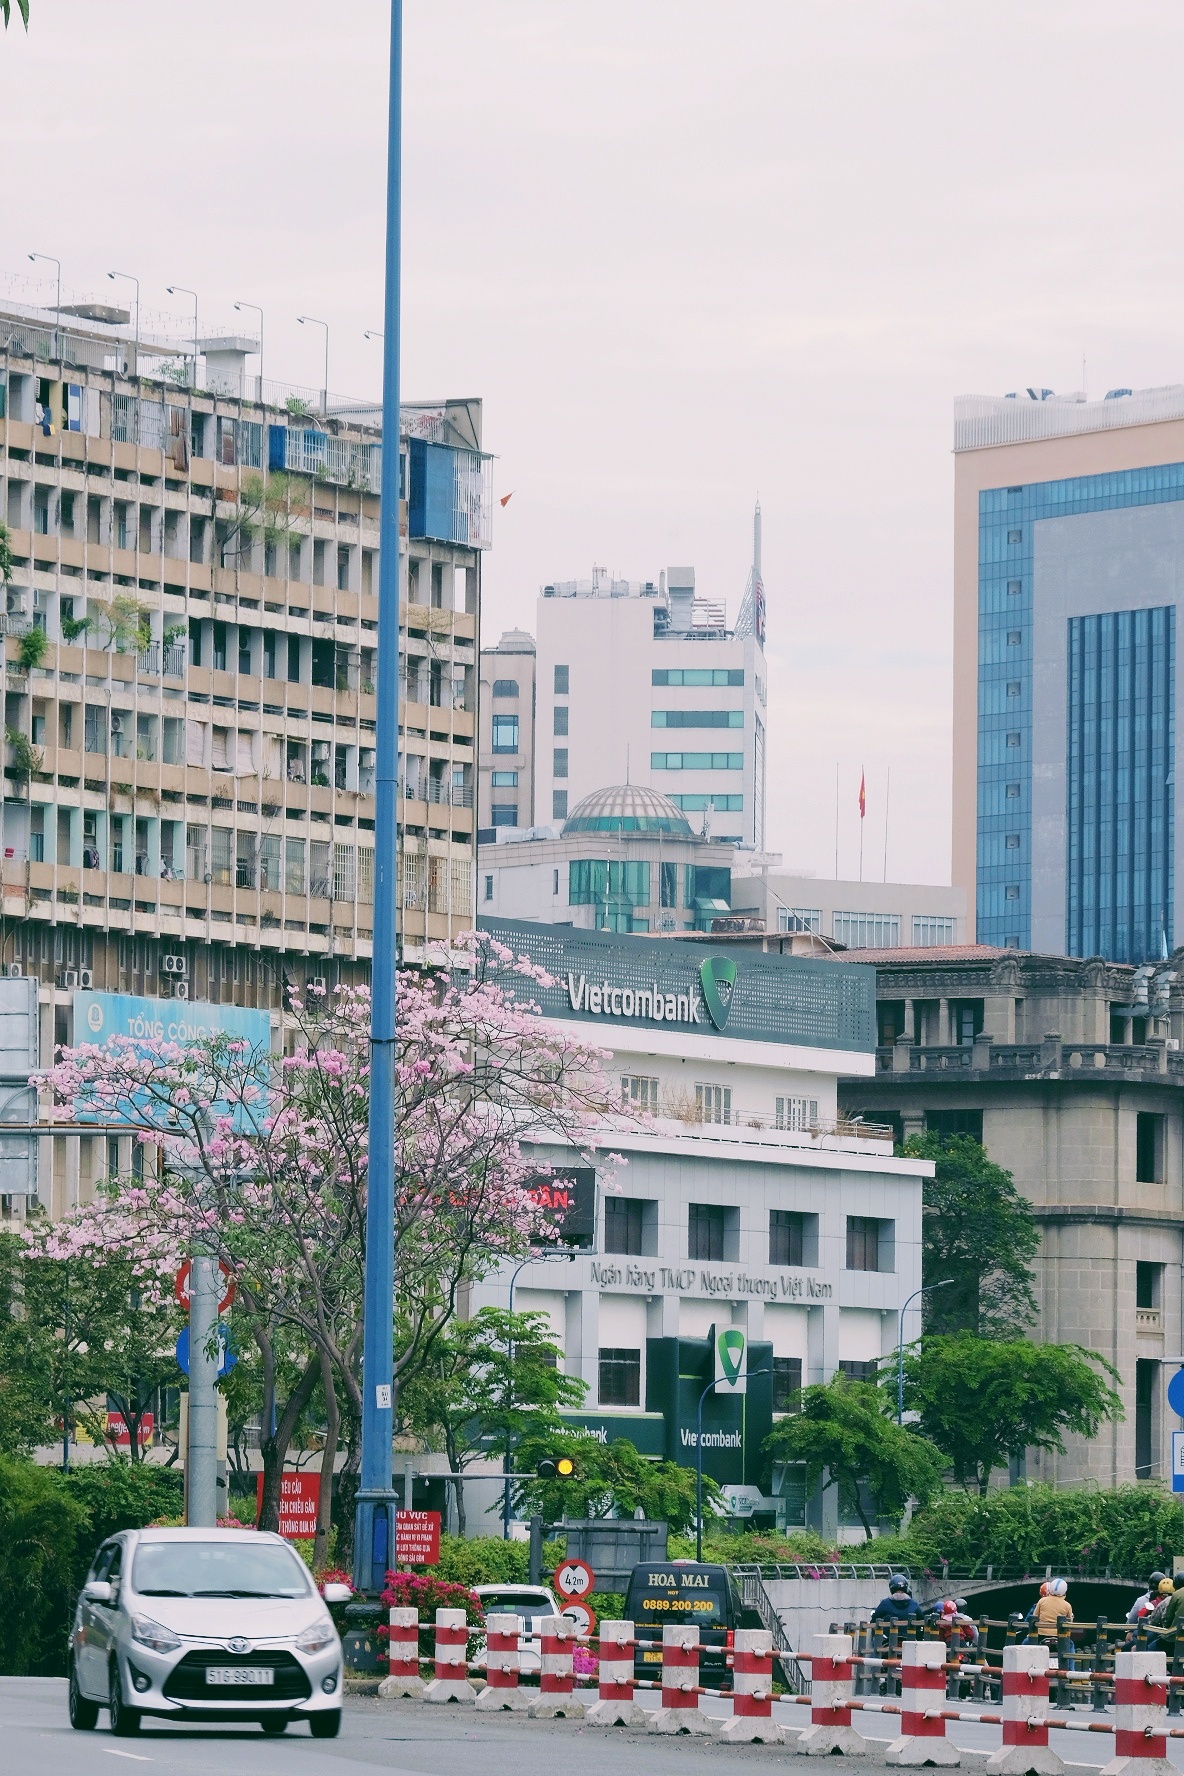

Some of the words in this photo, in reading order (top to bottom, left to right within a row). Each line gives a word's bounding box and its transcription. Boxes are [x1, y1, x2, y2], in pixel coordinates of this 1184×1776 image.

[568, 972, 701, 1024] Vietcombank
[127, 1011, 165, 1039] TỔNG
[167, 1019, 207, 1042] CÔNG
[626, 1264, 656, 1292] hàng
[659, 1267, 696, 1290] TMCP
[700, 1271, 734, 1297] Ngoại
[780, 1275, 804, 1301] Việt
[807, 1276, 833, 1299] Nam
[565, 1573, 584, 1586] 4.2m
[648, 1573, 676, 1587] HOA
[681, 1574, 710, 1588] MAI
[643, 1599, 714, 1611] 0889.200.200
